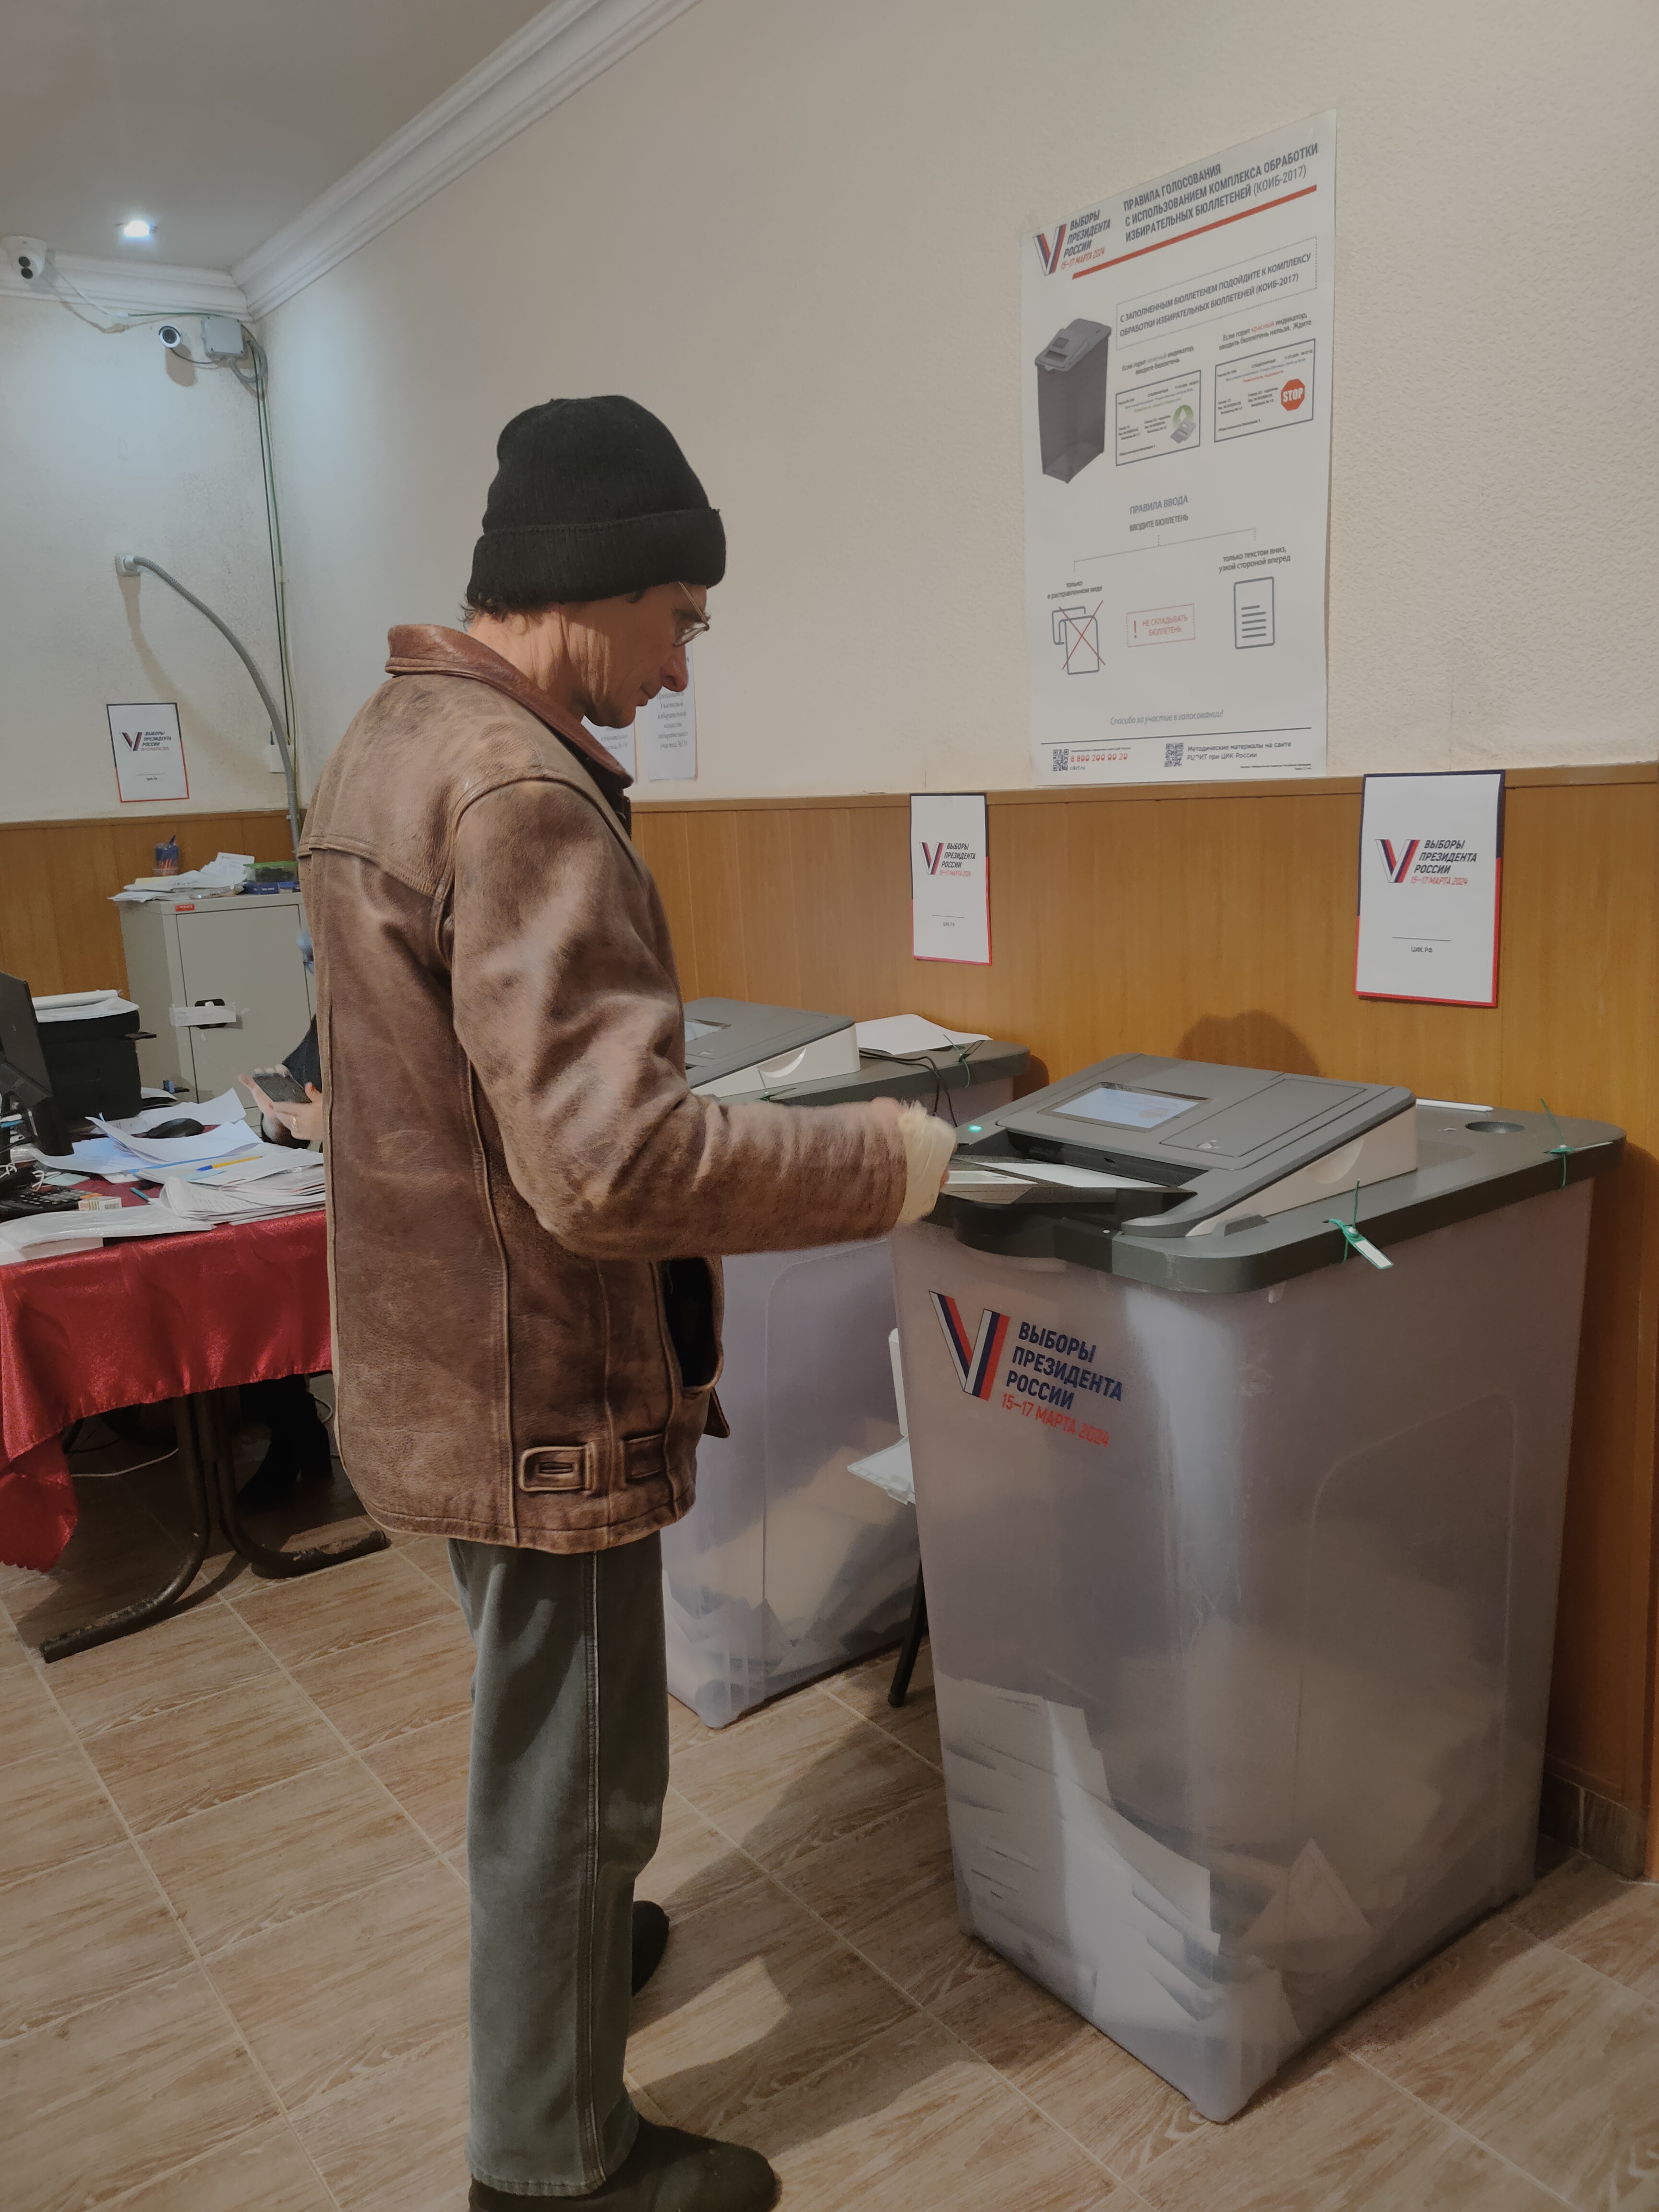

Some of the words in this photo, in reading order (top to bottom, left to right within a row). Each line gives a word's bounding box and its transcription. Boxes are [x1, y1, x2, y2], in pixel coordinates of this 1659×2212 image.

[1124, 189, 1160, 212] ПРАВИЛА
[1161, 164, 1221, 196] ГОЛОСОВАНИЯ
[1125, 216, 1130, 227] С
[1132, 185, 1207, 225] ИСПОЛЬЗОВАНИЕМ
[1209, 165, 1262, 195] КОМПЛЕКСА
[1264, 143, 1318, 173] ОБРАБОТКИ
[1126, 208, 1193, 242] ИЗБИРАТЕЛЬНЫХ
[1195, 183, 1251, 216] БЮЛЛЕТЕНЕЙ
[1253, 164, 1307, 197] (КОИБ-2017)
[1070, 210, 1100, 231] ВЫБОРЫ
[1067, 219, 1110, 245] ПРЕЗИДЕНТА
[1063, 240, 1092, 259] РОССИИ
[1075, 252, 1092, 265] МАРТА
[1093, 247, 1105, 259] 2024
[1125, 299, 1173, 321] ЗАПОЛНЕННЫМ
[1174, 284, 1217, 305] БЮЛЛЕТЕНЕМ
[1219, 269, 1261, 290] ПОДОЙДИТЕ
[1262, 268, 1266, 276] К
[1267, 252, 1311, 274] КОМПЛЕКСУ
[1120, 319, 1155, 337] ОБРАБОТКИ
[1156, 301, 1210, 326] ИЗБИРАТЕЛЬНЫХ
[1211, 286, 1255, 308] БЮЛЛЕТЕНЕЙ
[1256, 273, 1298, 294] (КОИБ-2017)
[1236, 328, 1250, 338] горит
[1293, 319, 1312, 330] Ждите
[1283, 387, 1303, 403] STOP
[1130, 501, 1162, 514] ПРАВИЛА
[1164, 495, 1188, 507] ВВОДА
[1130, 521, 1154, 531] ВВОДИТЕ
[1155, 514, 1189, 526] БЮЛЛЕТЕНЬ
[1237, 558, 1266, 569] стороной
[1245, 550, 1268, 558] текстом
[1110, 716, 1136, 725] Спасибо
[1144, 715, 1172, 724] участие
[1424, 840, 1465, 849] ВЫБОРЫ
[1419, 852, 1477, 863] ПРЕЗИДЕНТА
[1414, 865, 1451, 874] РОССИИ
[1018, 1322, 1096, 1363] ВЫБОРЫ
[1012, 1346, 1124, 1402] ПРЕЗИДЕНТА
[1006, 1370, 1074, 1410] РОССИИ
[1035, 1406, 1076, 1435] МАРТА
[1078, 1422, 1110, 1448] 2024
